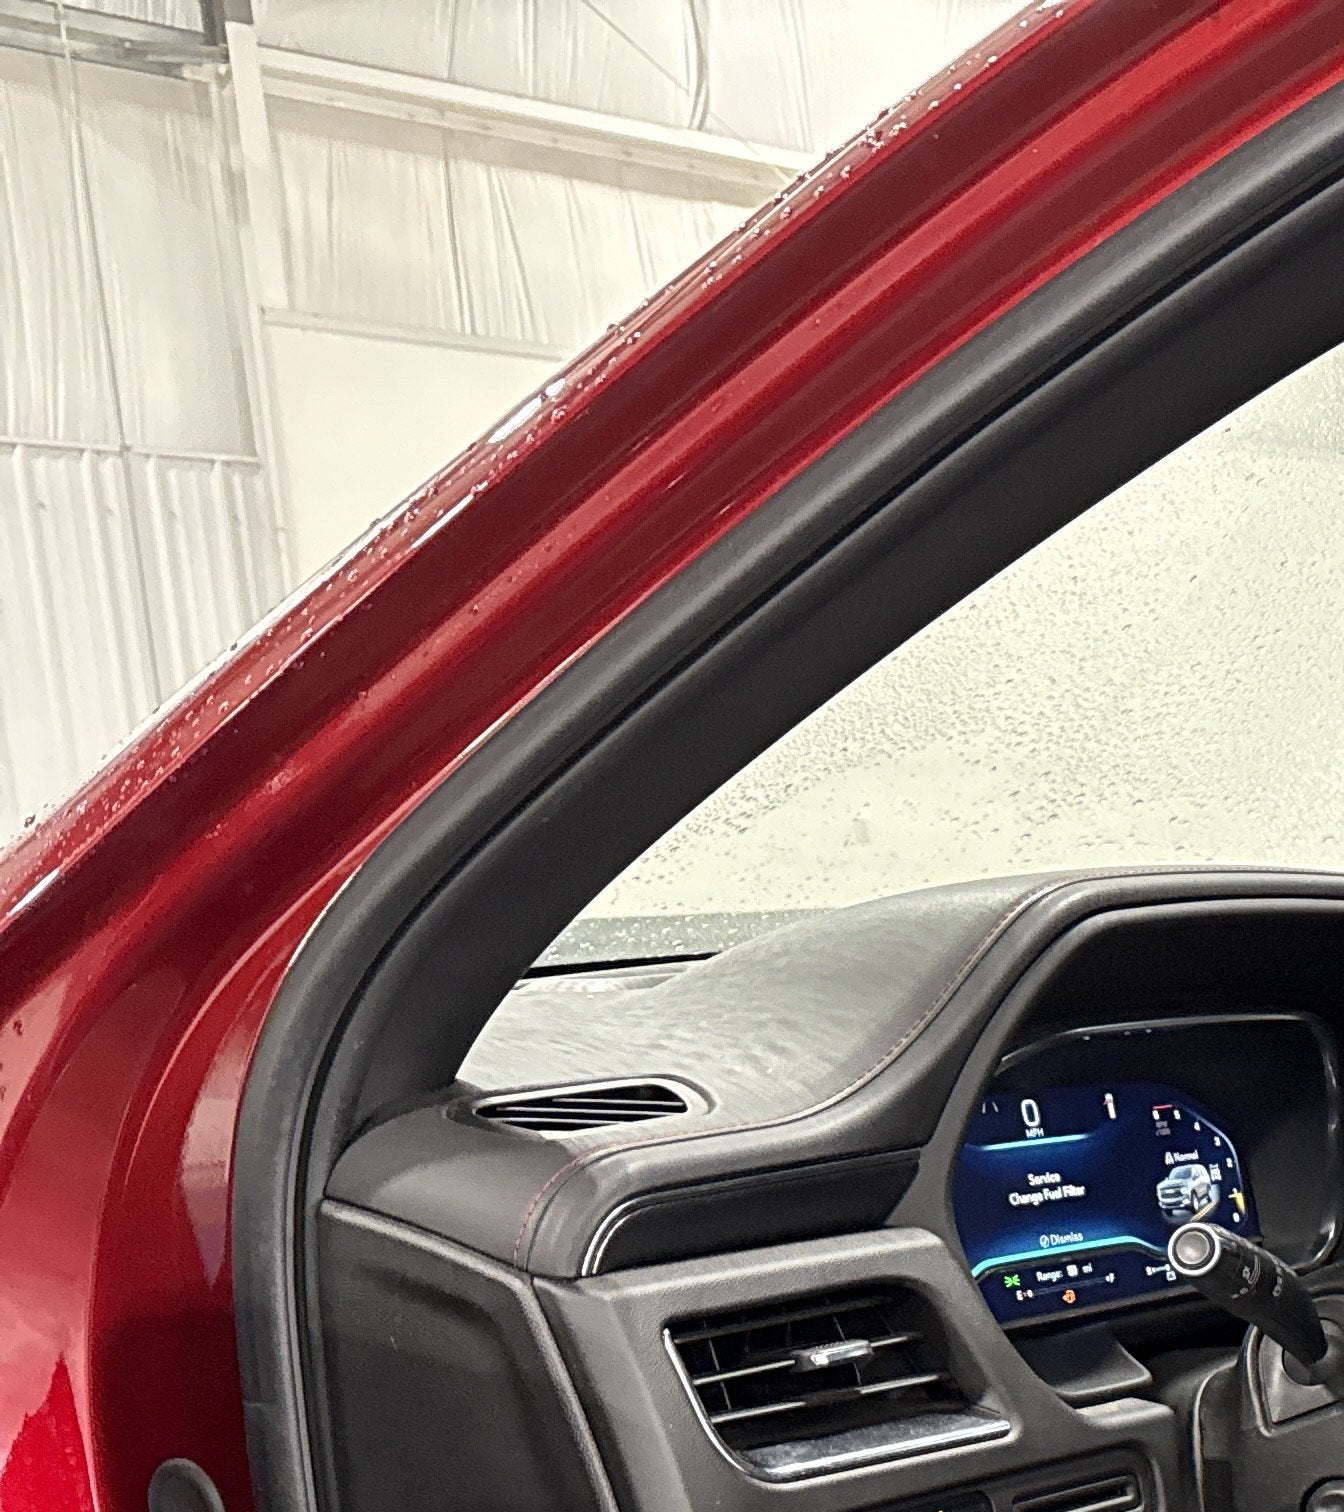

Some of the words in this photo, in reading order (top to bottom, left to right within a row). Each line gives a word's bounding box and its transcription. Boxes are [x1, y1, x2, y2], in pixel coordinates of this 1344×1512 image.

[1020, 1099, 1040, 1127] 0
[1025, 1127, 1045, 1139] MPH
[1027, 1172, 1061, 1186] Service
[1008, 1191, 1044, 1206] Change
[1042, 1186, 1063, 1200] Fuel
[1061, 1184, 1086, 1198] Filter
[1050, 1231, 1084, 1246] Dismiss
